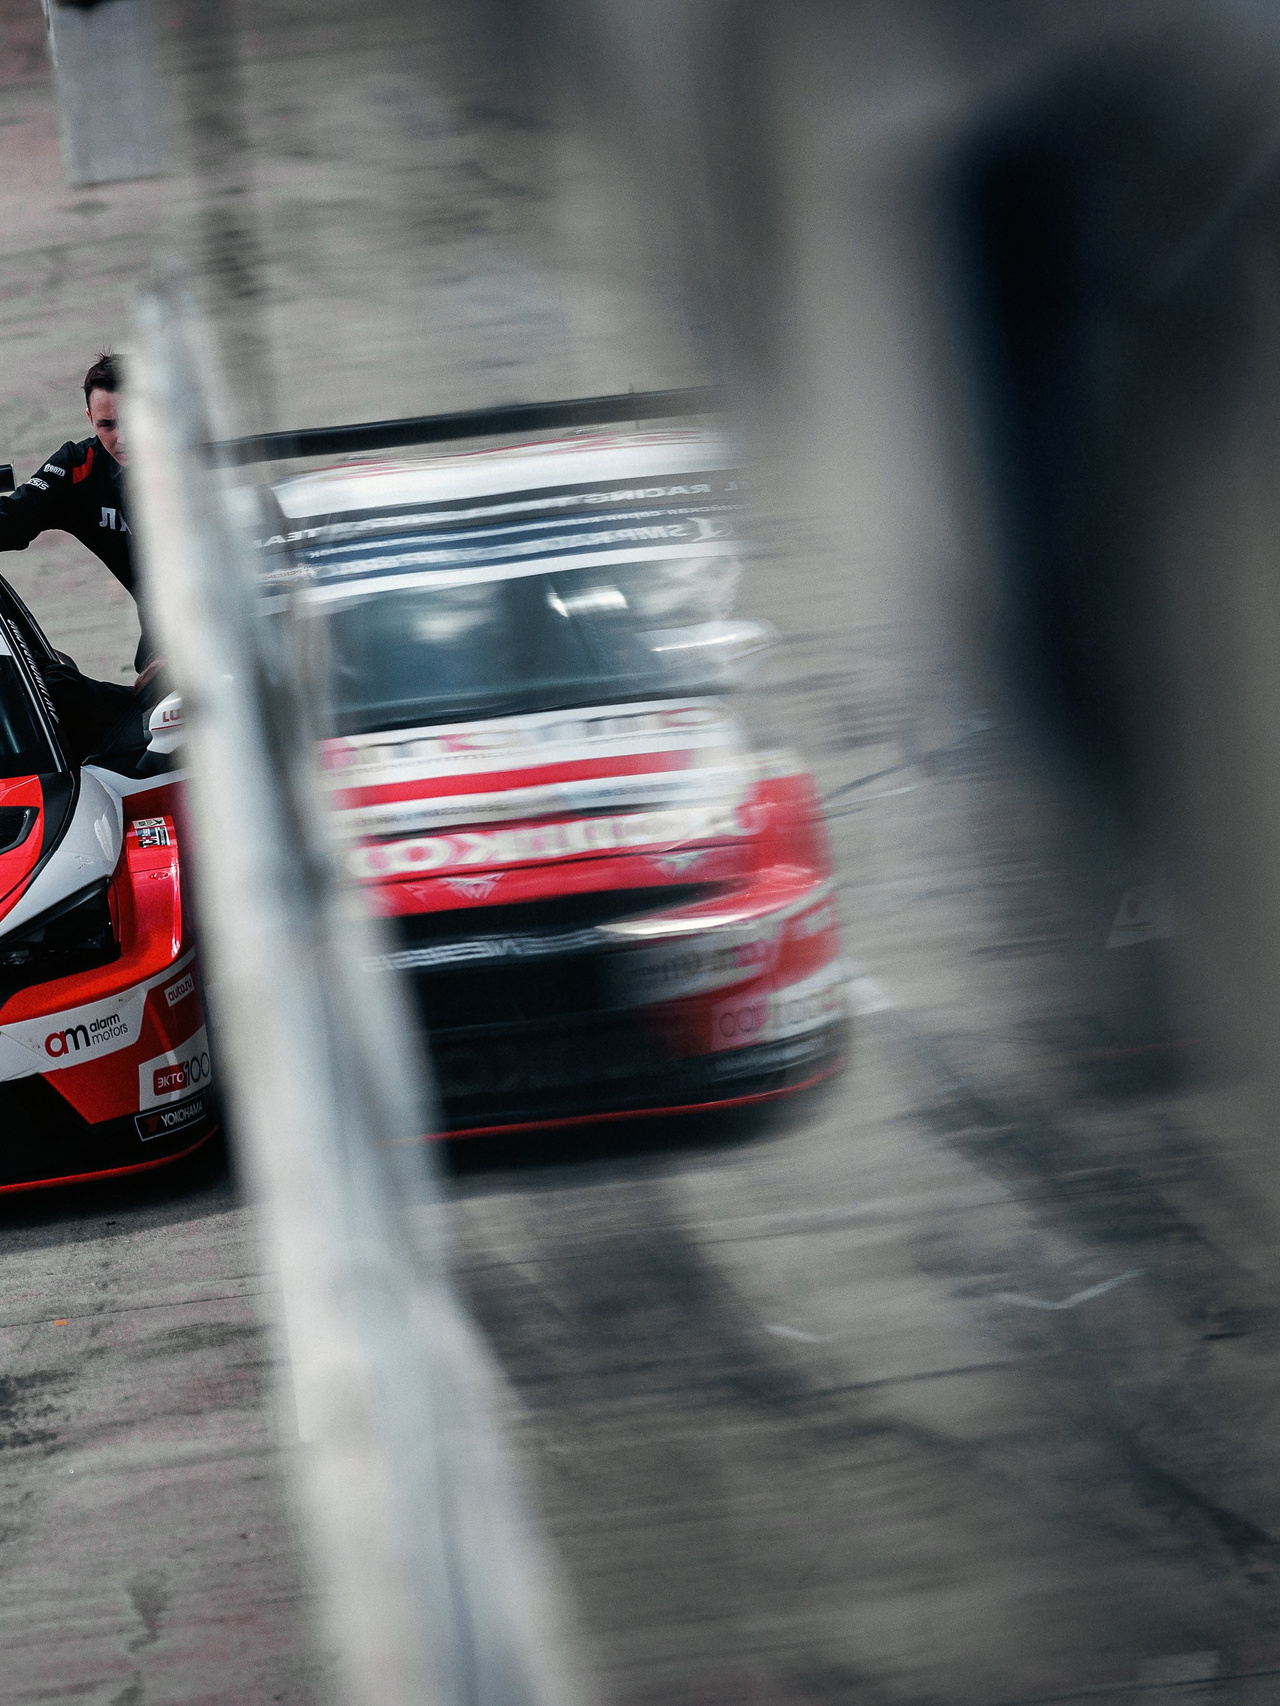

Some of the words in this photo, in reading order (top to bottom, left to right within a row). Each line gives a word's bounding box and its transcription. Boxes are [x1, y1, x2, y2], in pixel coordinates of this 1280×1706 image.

[168, 977, 193, 1002] auto.ru
[89, 1013, 121, 1033] alarm
[91, 1022, 128, 1046] motors
[44, 1024, 91, 1058] am
[161, 1100, 203, 1127] YOKOHAMA
